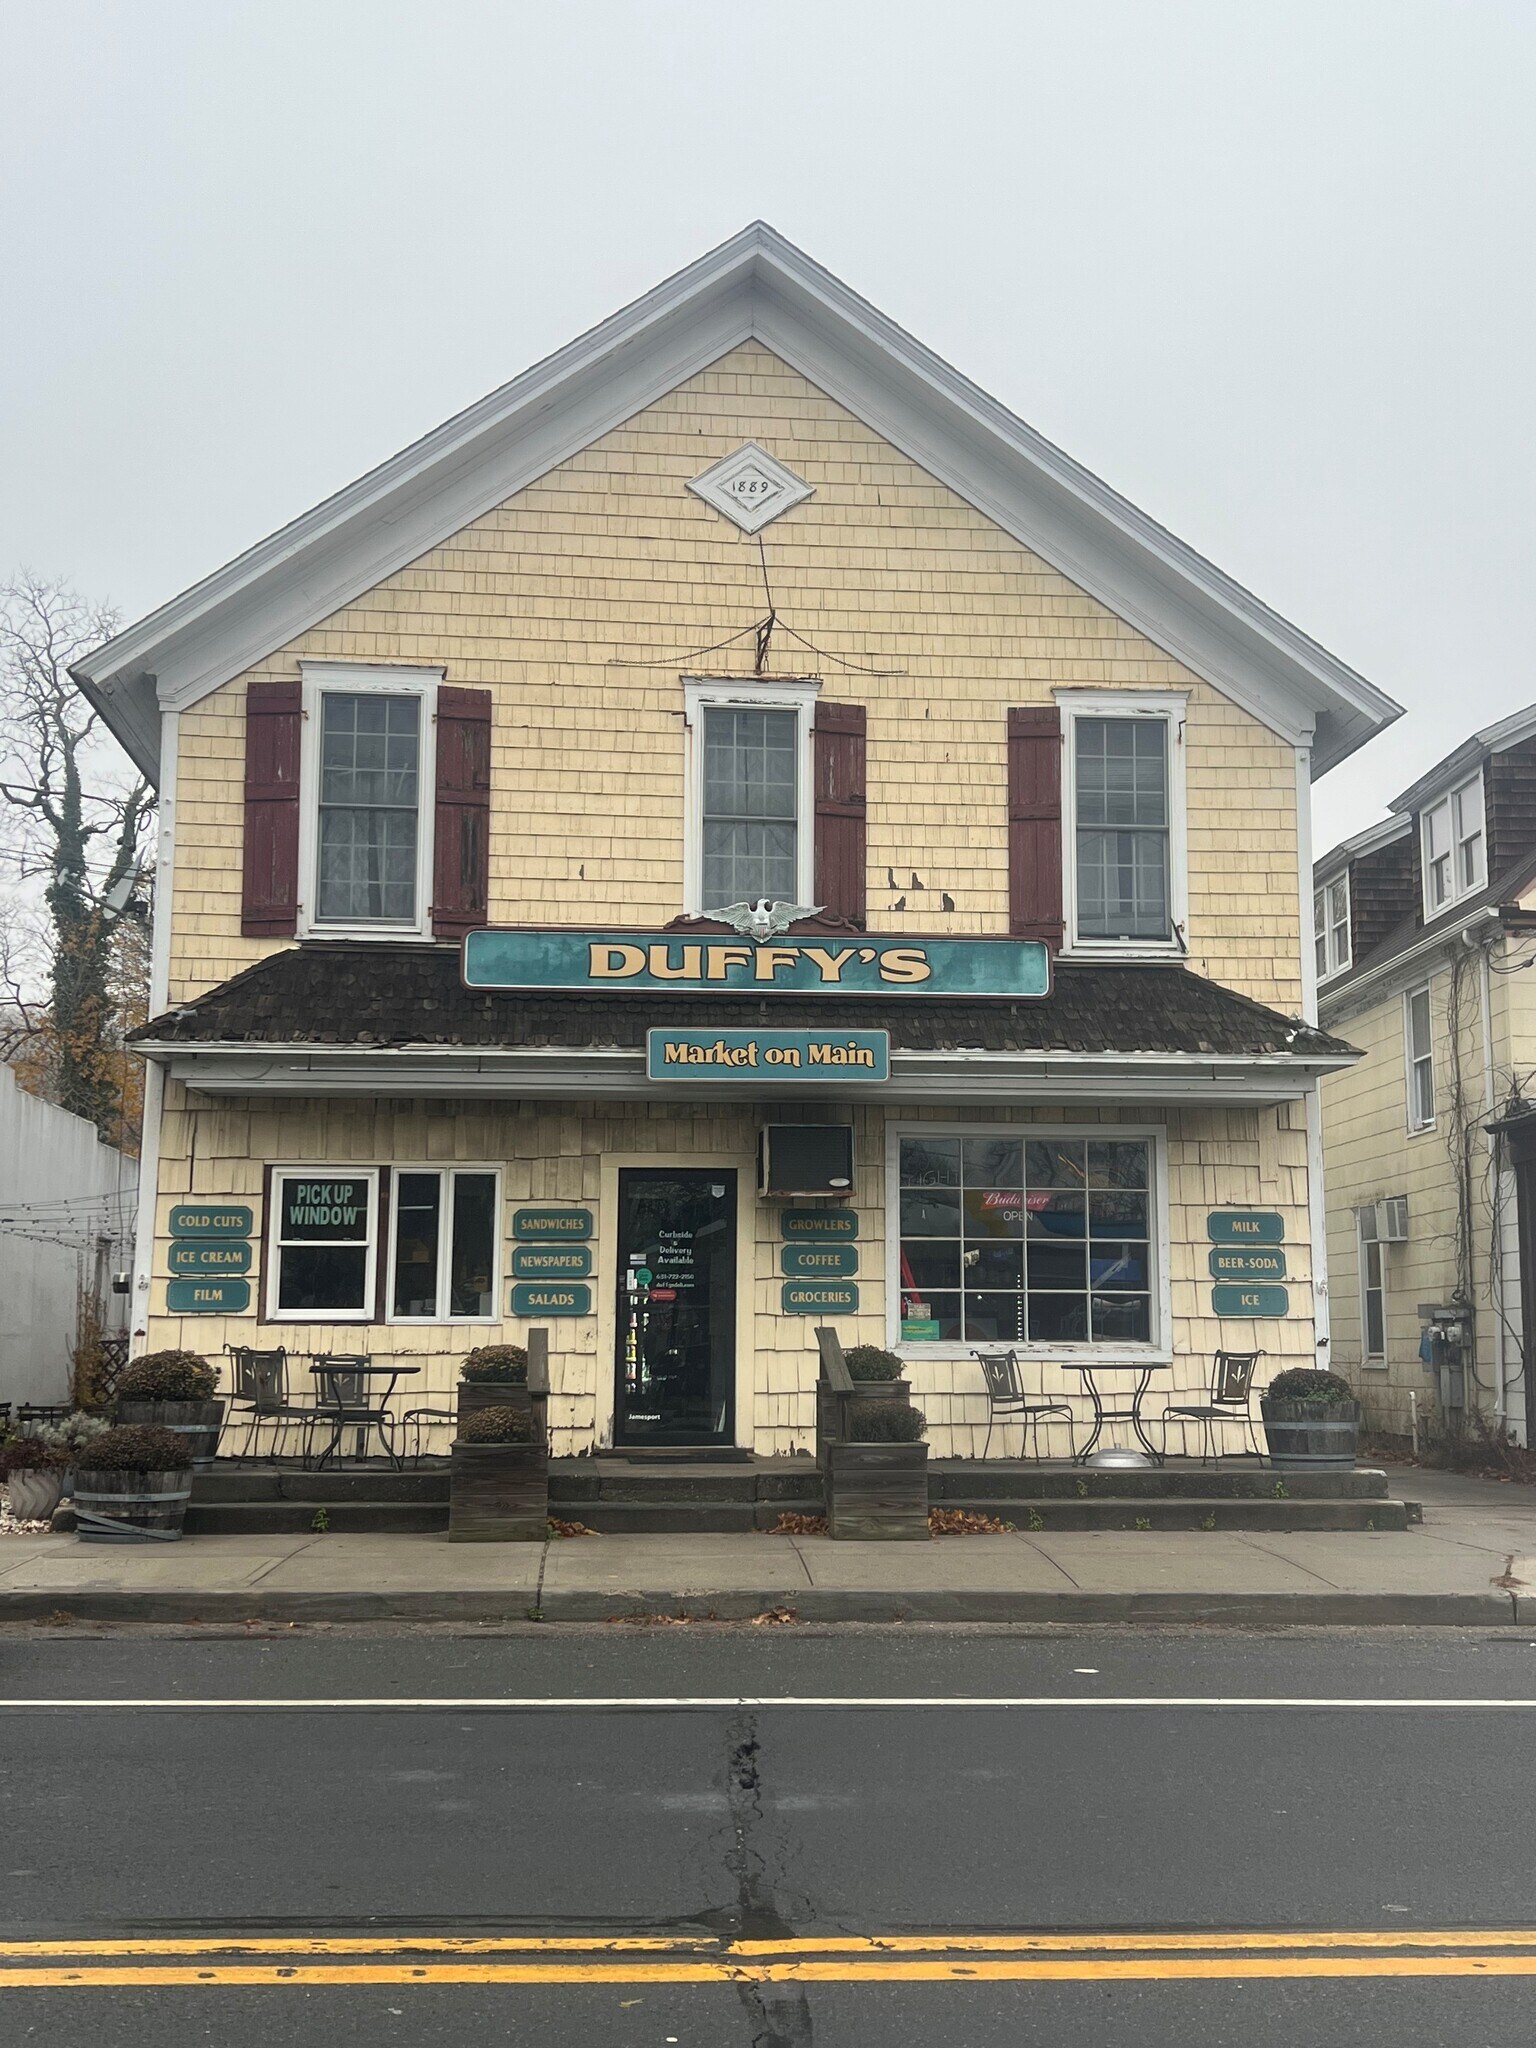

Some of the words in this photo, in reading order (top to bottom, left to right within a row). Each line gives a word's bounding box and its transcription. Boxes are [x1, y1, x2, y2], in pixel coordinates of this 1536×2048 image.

[732, 480, 769, 493] 1889
[587, 942, 932, 984] DUFFY'S
[663, 1040, 759, 1068] Market
[764, 1048, 802, 1068] on
[806, 1040, 876, 1068] Main
[297, 1184, 332, 1204] PICK
[334, 1185, 354, 1204] UP
[982, 1192, 1050, 1206] Budwiser
[178, 1215, 210, 1227] COLD
[213, 1215, 243, 1227] CUTS
[289, 1205, 358, 1226] WINDOW
[1003, 1211, 1034, 1221] OPEN
[521, 1218, 584, 1230] SANDWICHES
[789, 1219, 851, 1230] GROWLERS
[1232, 1221, 1260, 1232] MILK
[658, 1230, 693, 1239] Curbside
[659, 1246, 692, 1255] Delivery
[176, 1251, 195, 1264] ICE
[200, 1251, 242, 1264] CREAM
[520, 1255, 583, 1267] NEWSPAPERS
[657, 1255, 694, 1264] Available
[798, 1254, 841, 1265] COFFEE
[1218, 1257, 1278, 1269] BEER-SODA
[193, 1289, 223, 1302] FILM
[528, 1294, 574, 1305] SALADS
[790, 1292, 851, 1302] GROCERIES
[1241, 1294, 1260, 1306] ICE
